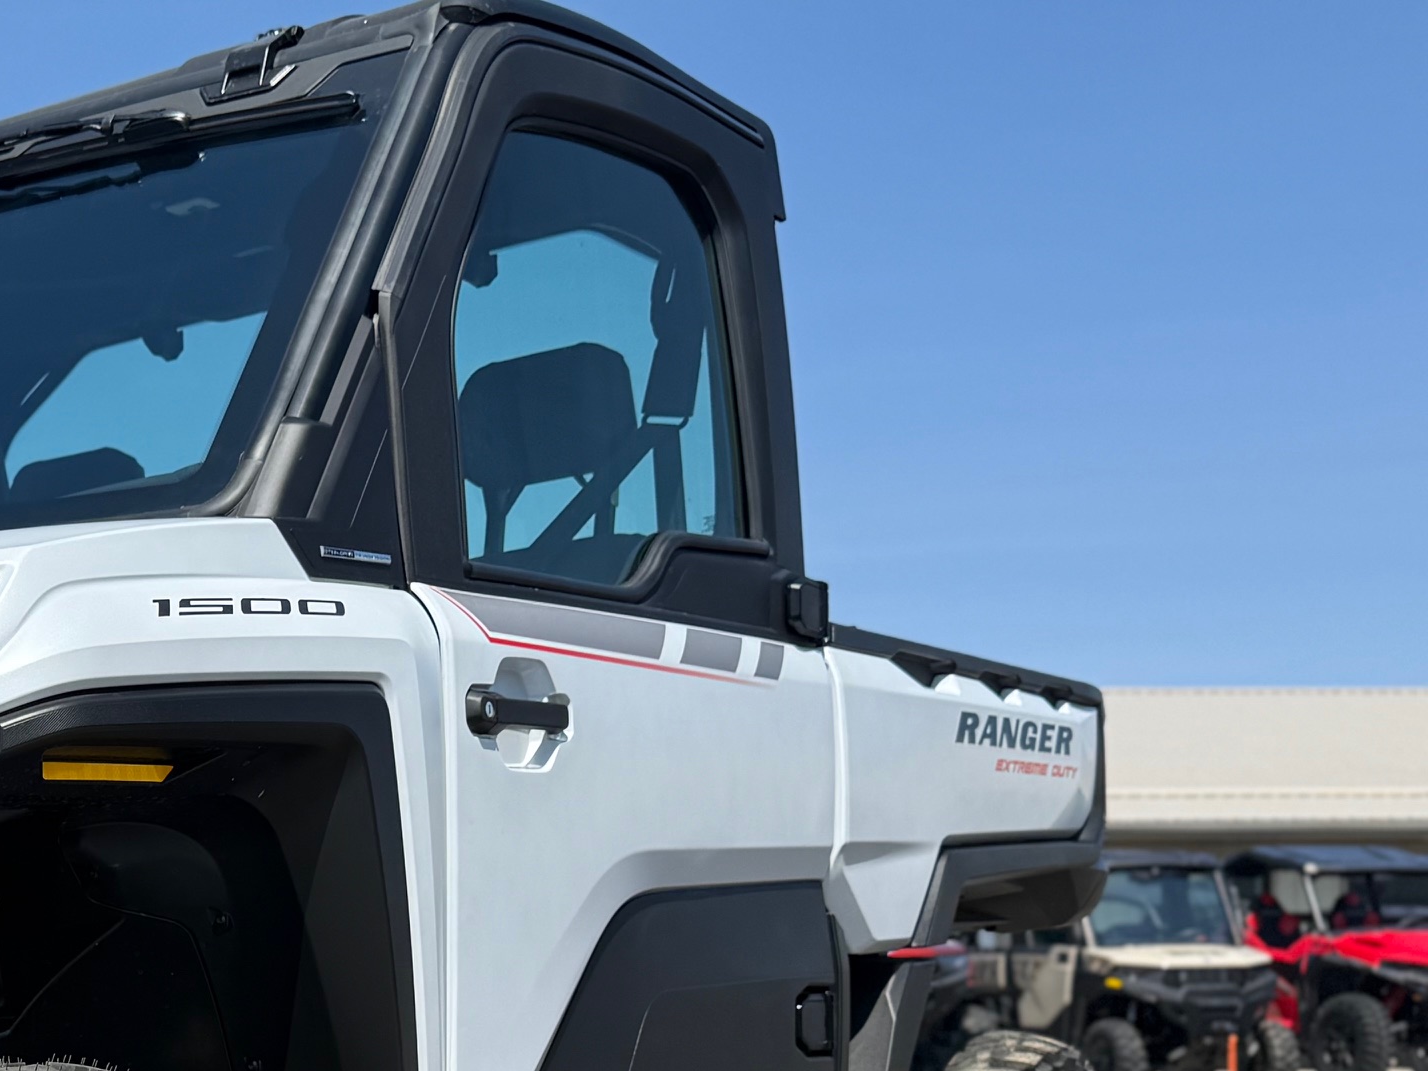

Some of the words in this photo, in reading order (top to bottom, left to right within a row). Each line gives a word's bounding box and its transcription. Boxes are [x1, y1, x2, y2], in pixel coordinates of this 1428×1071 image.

[152, 597, 346, 617] 1500
[955, 711, 1073, 755] RANGER
[995, 758, 1048, 777] EXTREME
[1051, 763, 1078, 778] DUTY
